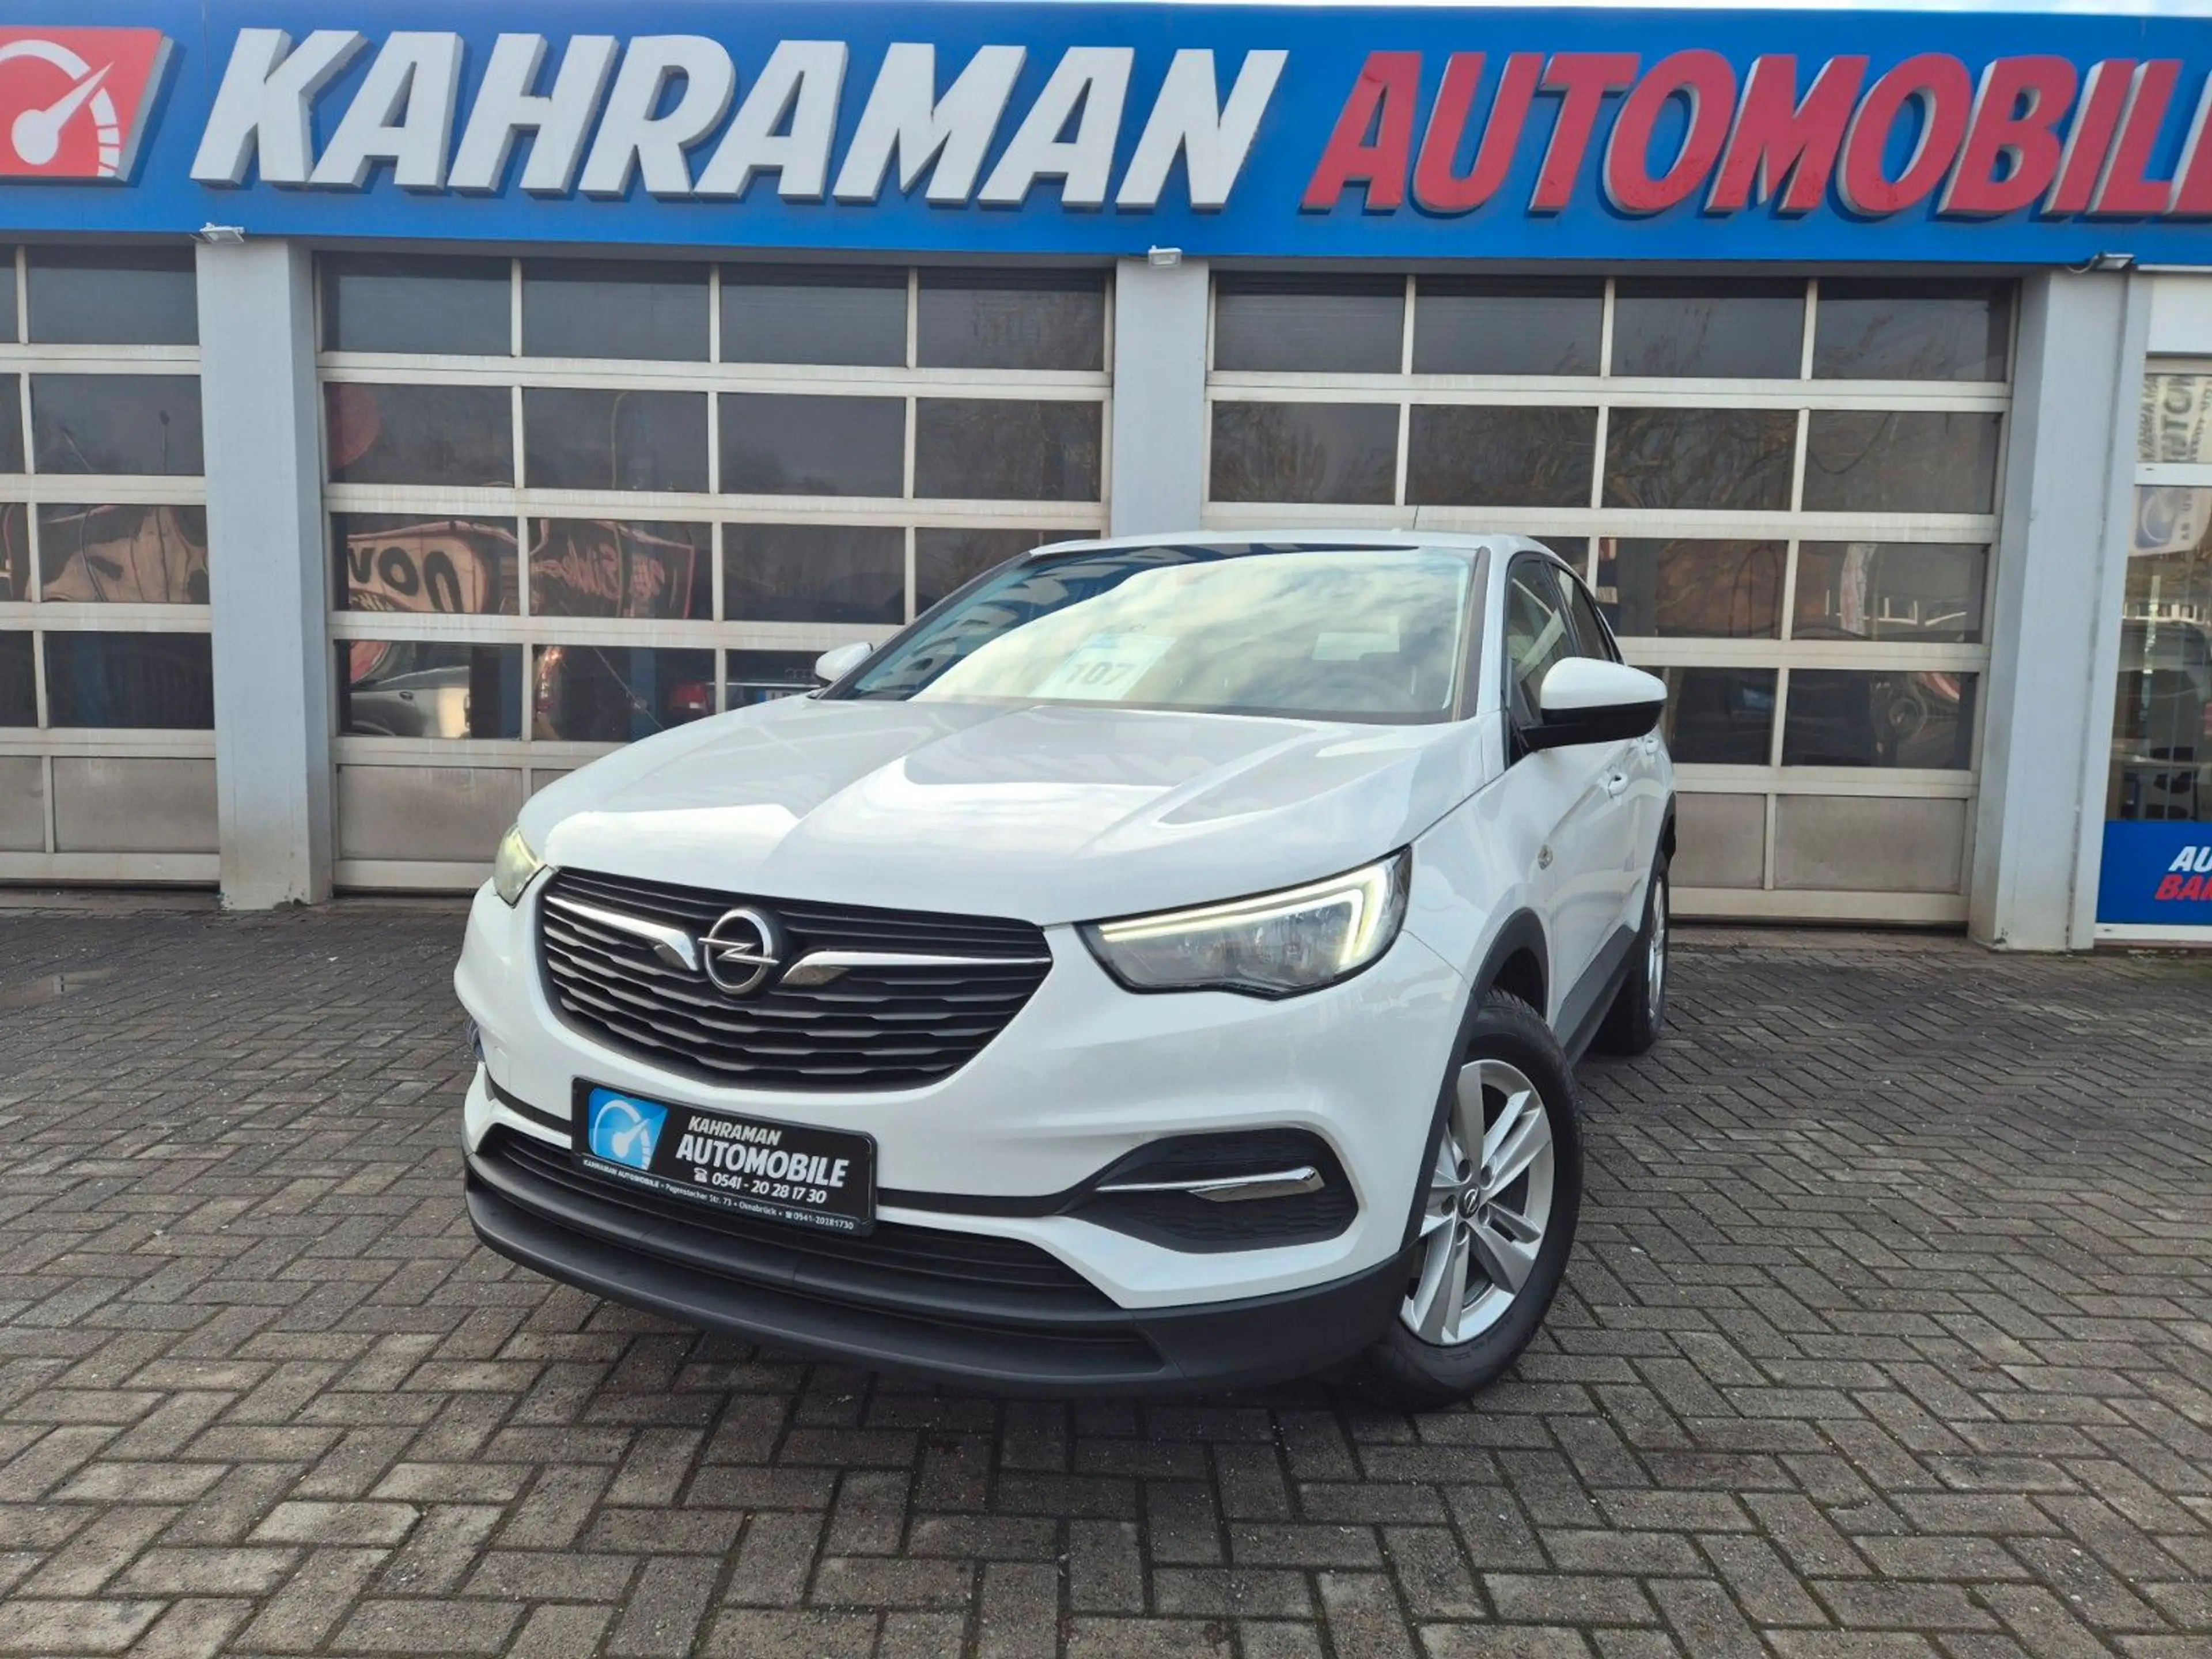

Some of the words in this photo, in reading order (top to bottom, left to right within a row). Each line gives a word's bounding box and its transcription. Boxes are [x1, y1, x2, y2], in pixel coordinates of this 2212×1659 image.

[190, 28, 1289, 210] KAHRAMAN
[1065, 661, 1135, 685] 107
[688, 1115, 782, 1145] KAHRAMAN
[675, 1133, 850, 1188] AUTOMOBILE
[712, 1172, 742, 1190] 0541
[751, 1180, 770, 1195] 20
[771, 1183, 789, 1199] 28
[791, 1187, 806, 1200] 17
[806, 1190, 827, 1204] 30
